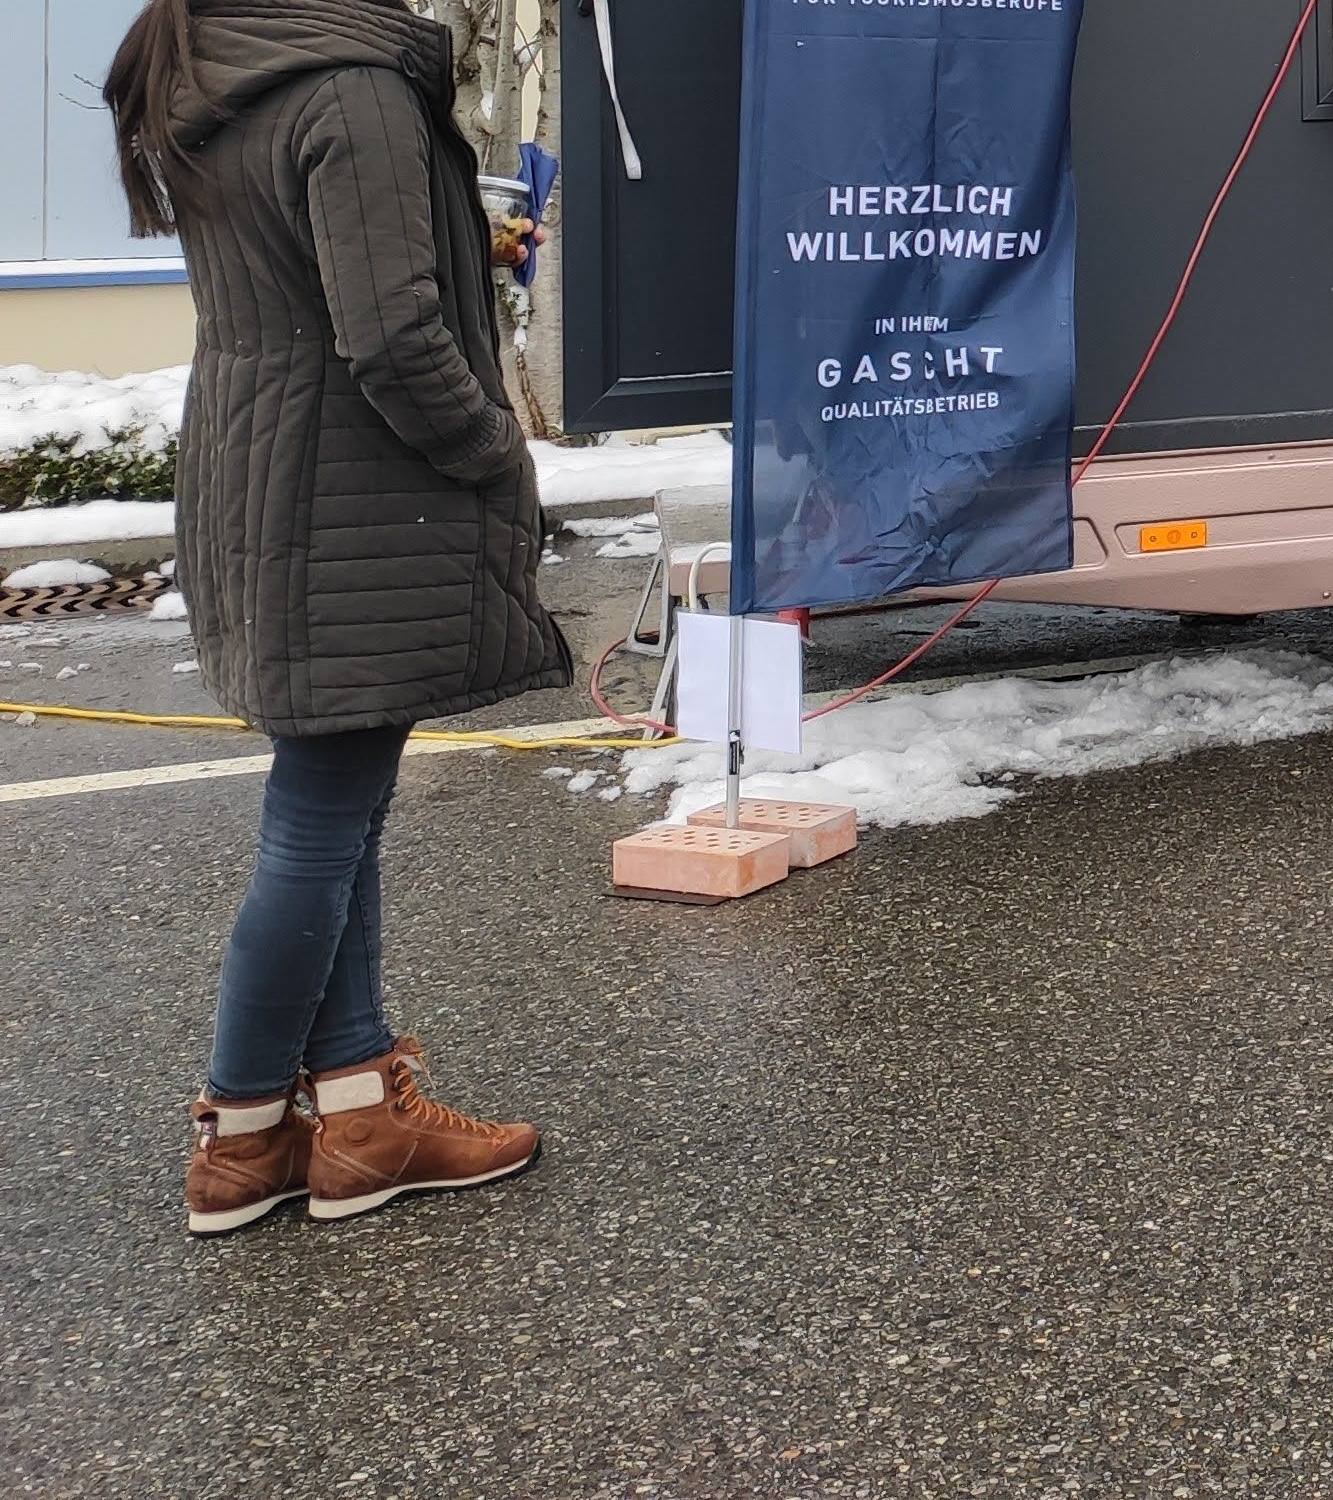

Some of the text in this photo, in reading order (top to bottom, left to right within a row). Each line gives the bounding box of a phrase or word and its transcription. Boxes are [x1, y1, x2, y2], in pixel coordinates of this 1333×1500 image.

[829, 184, 1013, 216] HERZLICH
[786, 228, 1042, 262] WILLKOMMEN
[875, 317, 895, 335] IN
[821, 391, 1000, 422] QUALITÄTSBETRIEB
